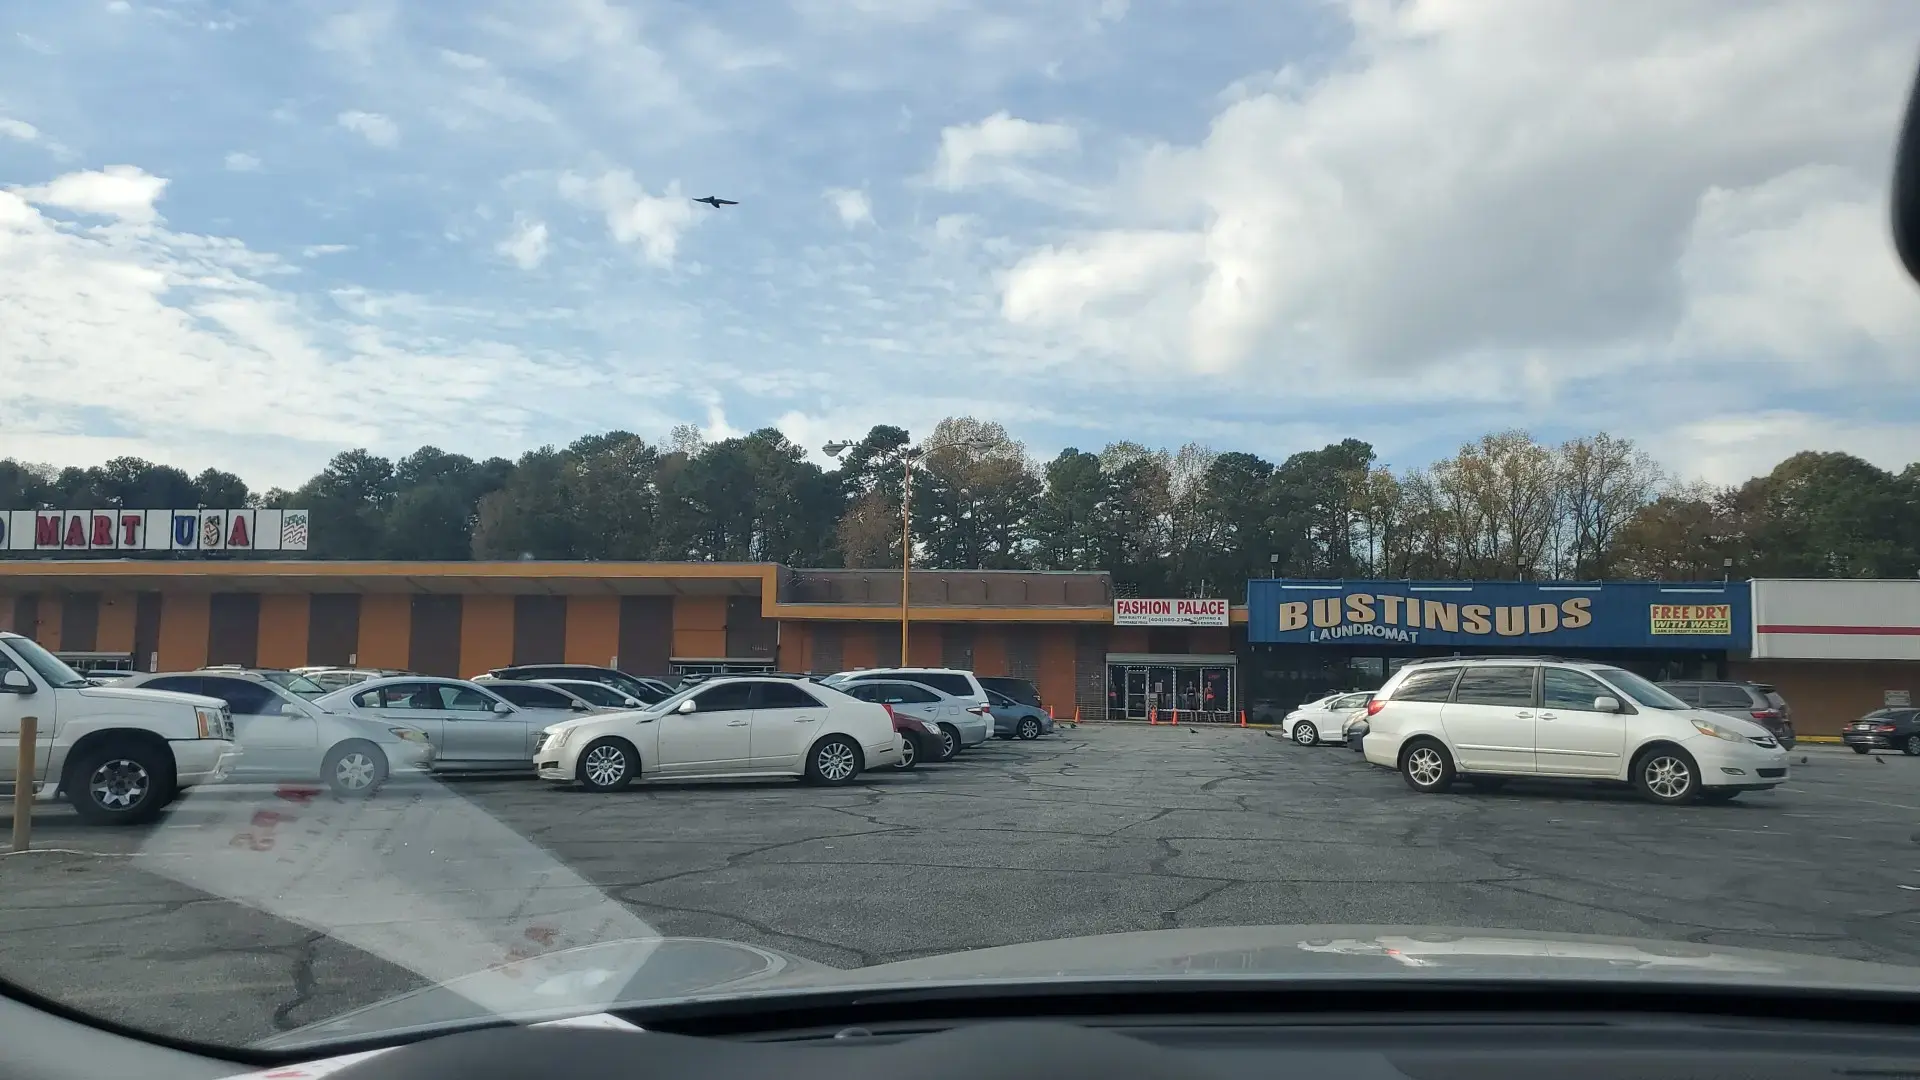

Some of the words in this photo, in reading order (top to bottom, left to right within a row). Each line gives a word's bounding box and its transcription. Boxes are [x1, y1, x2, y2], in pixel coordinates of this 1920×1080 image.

[36, 515, 140, 546] MART
[174, 515, 250, 546] USA
[1117, 600, 1171, 615] FASHION
[1177, 601, 1225, 615] PALACE
[1279, 593, 1592, 636] BUSTINSUDS
[1652, 606, 1690, 619] FREE
[1695, 606, 1728, 619] DRY
[1655, 620, 1688, 628] WITH
[1690, 620, 1727, 628] WASH
[1310, 625, 1418, 643] LAUNDROMAT
